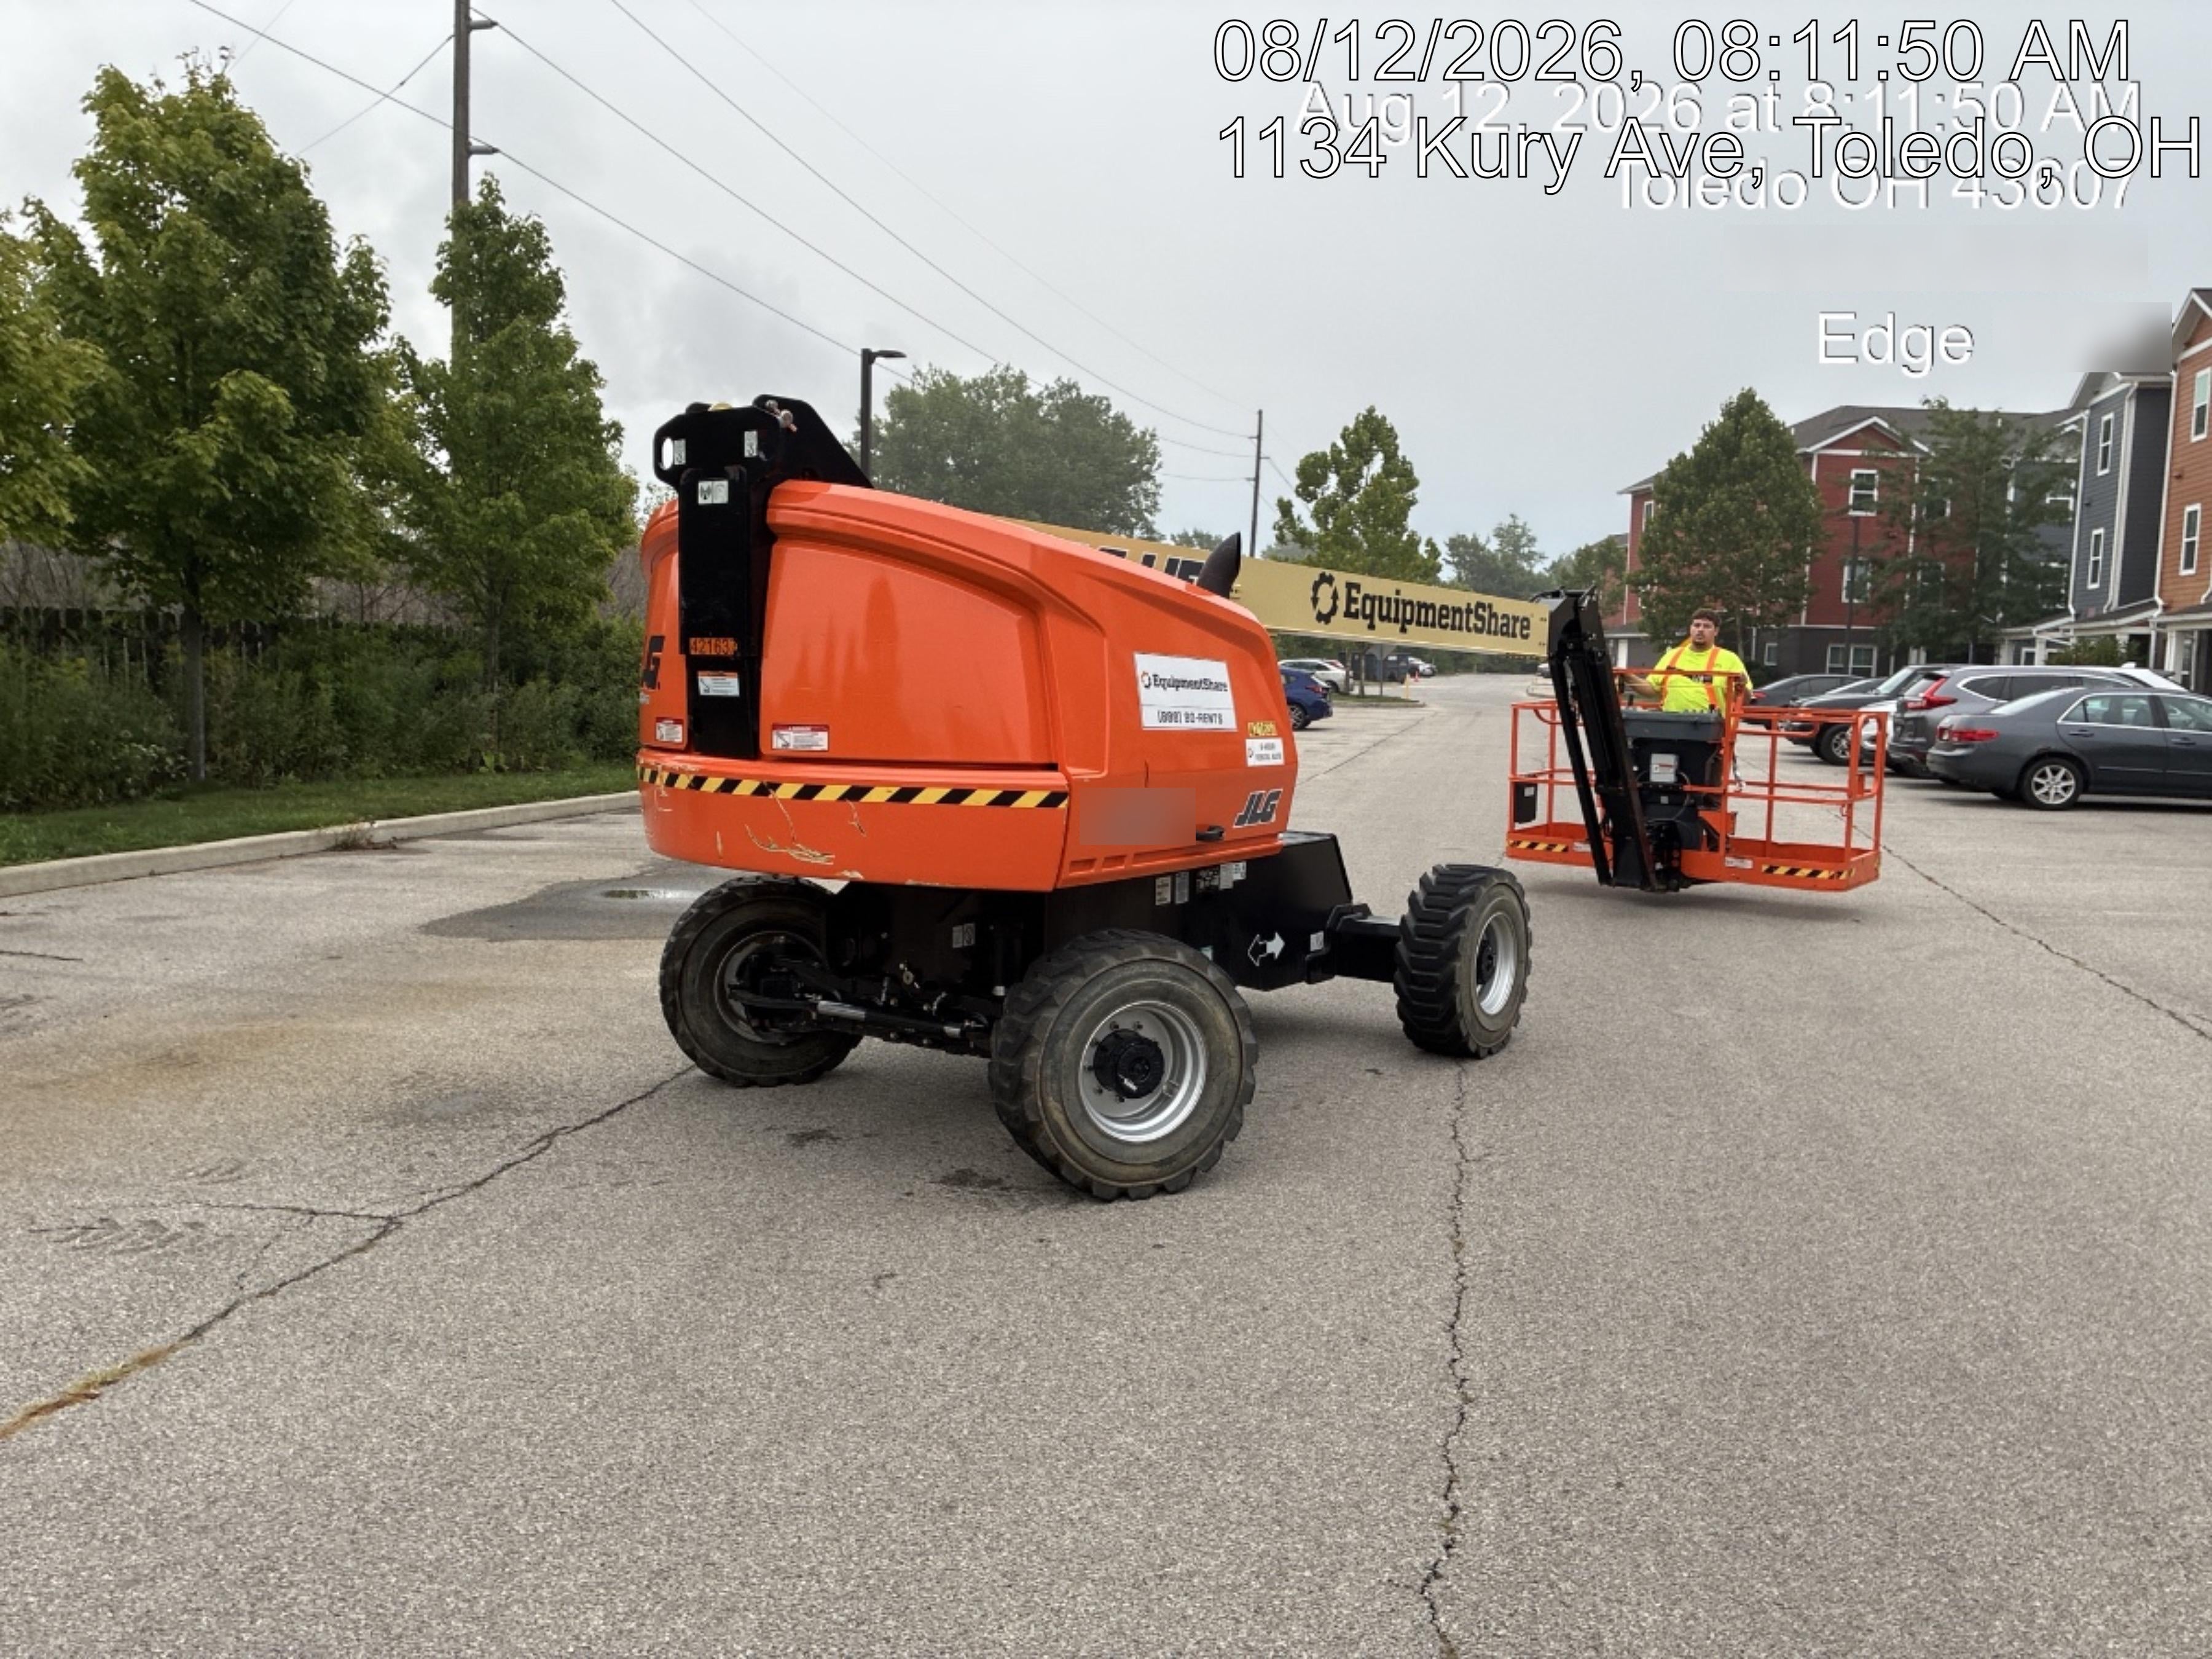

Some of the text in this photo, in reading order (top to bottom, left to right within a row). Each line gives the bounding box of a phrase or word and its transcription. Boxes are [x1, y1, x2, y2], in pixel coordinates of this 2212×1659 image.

[1343, 581, 1531, 640] EquipmentShare
[1151, 673, 1228, 692] EquipmentShare
[1233, 788, 1283, 828] JLG
